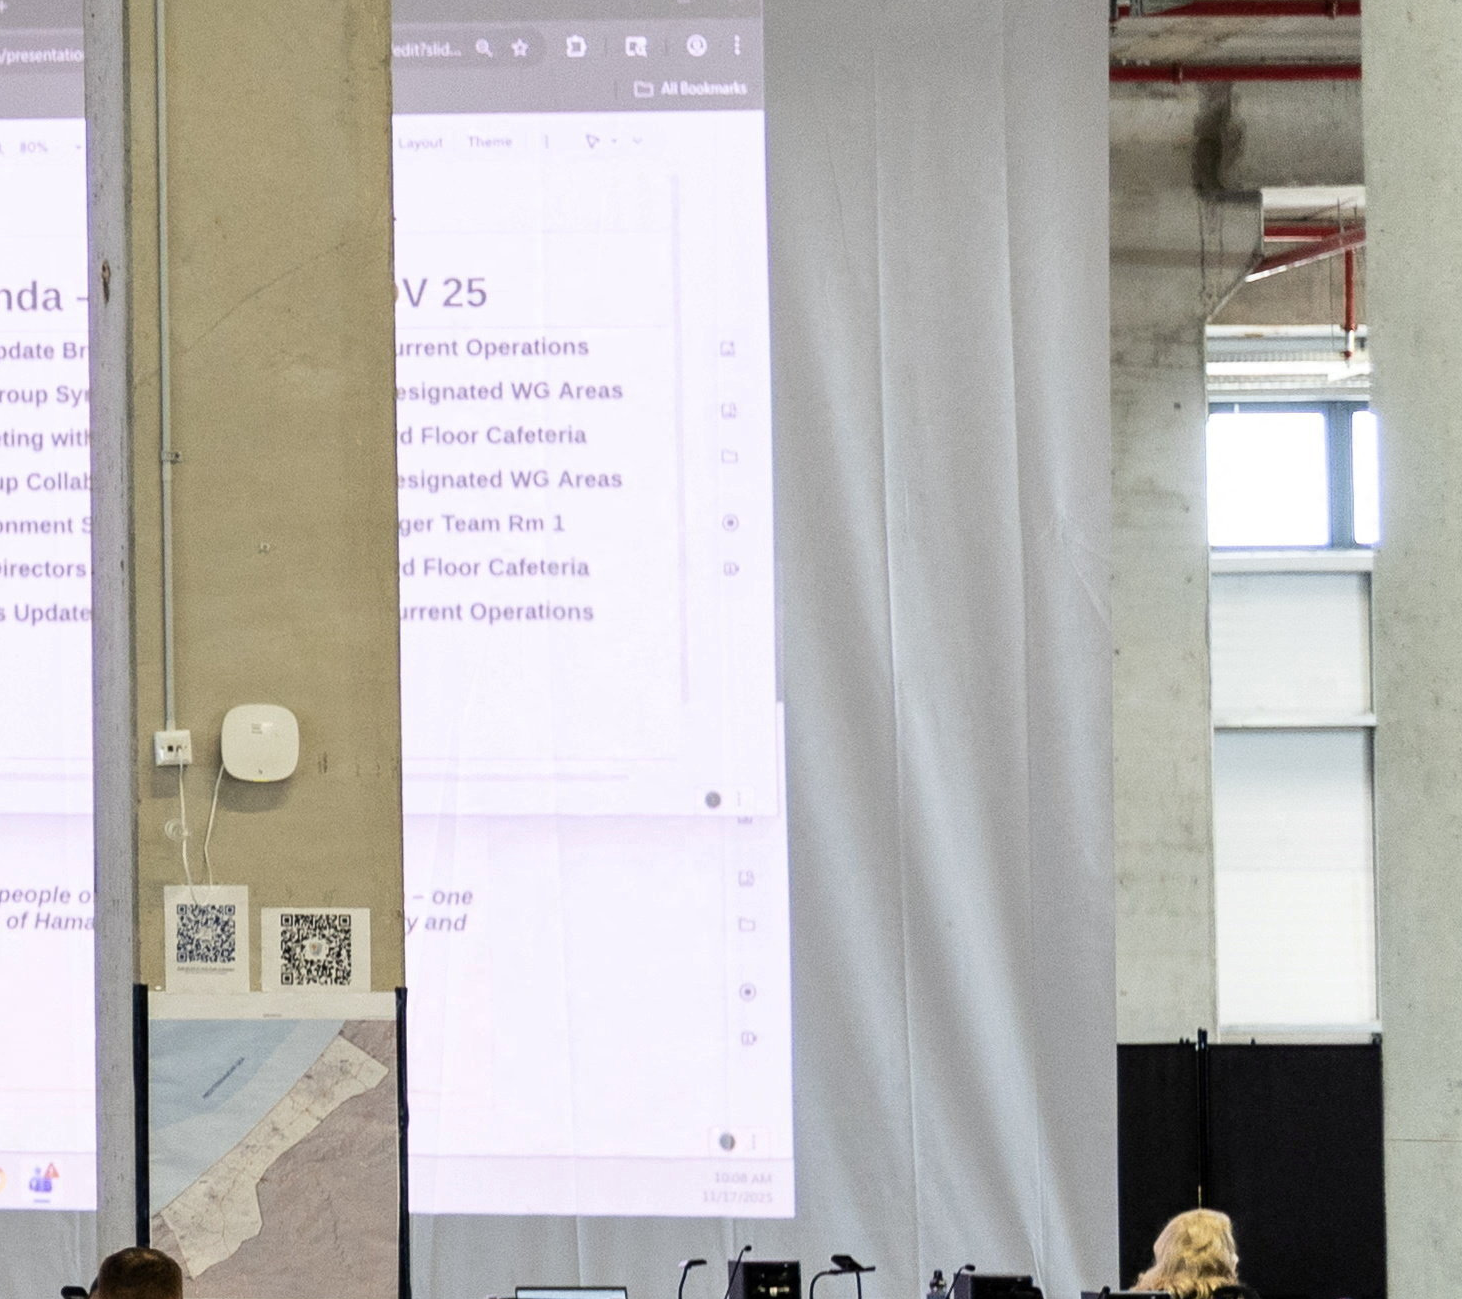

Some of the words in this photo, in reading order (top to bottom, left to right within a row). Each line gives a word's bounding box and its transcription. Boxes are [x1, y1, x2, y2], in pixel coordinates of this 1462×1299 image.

[442, 277, 487, 308] 25
[62, 341, 86, 360] Br
[398, 340, 458, 357] urrent
[465, 337, 590, 361] Operations
[396, 381, 504, 406] esignated
[510, 381, 551, 401] WG
[558, 381, 624, 400] Areas
[421, 425, 478, 445] Floor
[485, 425, 587, 445] Cafeteria
[399, 469, 503, 494] esignated
[510, 469, 550, 489] WG
[558, 470, 623, 488] Areas
[399, 518, 434, 538] ger
[442, 514, 501, 533] Team
[508, 514, 545, 532] Rm
[554, 514, 565, 532] 1
[423, 557, 480, 577] Floor
[488, 557, 590, 577] Cafeteria
[13, 603, 91, 627] Update
[402, 603, 463, 621] urrent
[469, 602, 594, 626] Operations
[78, 890, 92, 904] o
[431, 890, 474, 906] one
[5, 911, 29, 930] of
[34, 912, 93, 931] Hama
[424, 913, 468, 932] and
